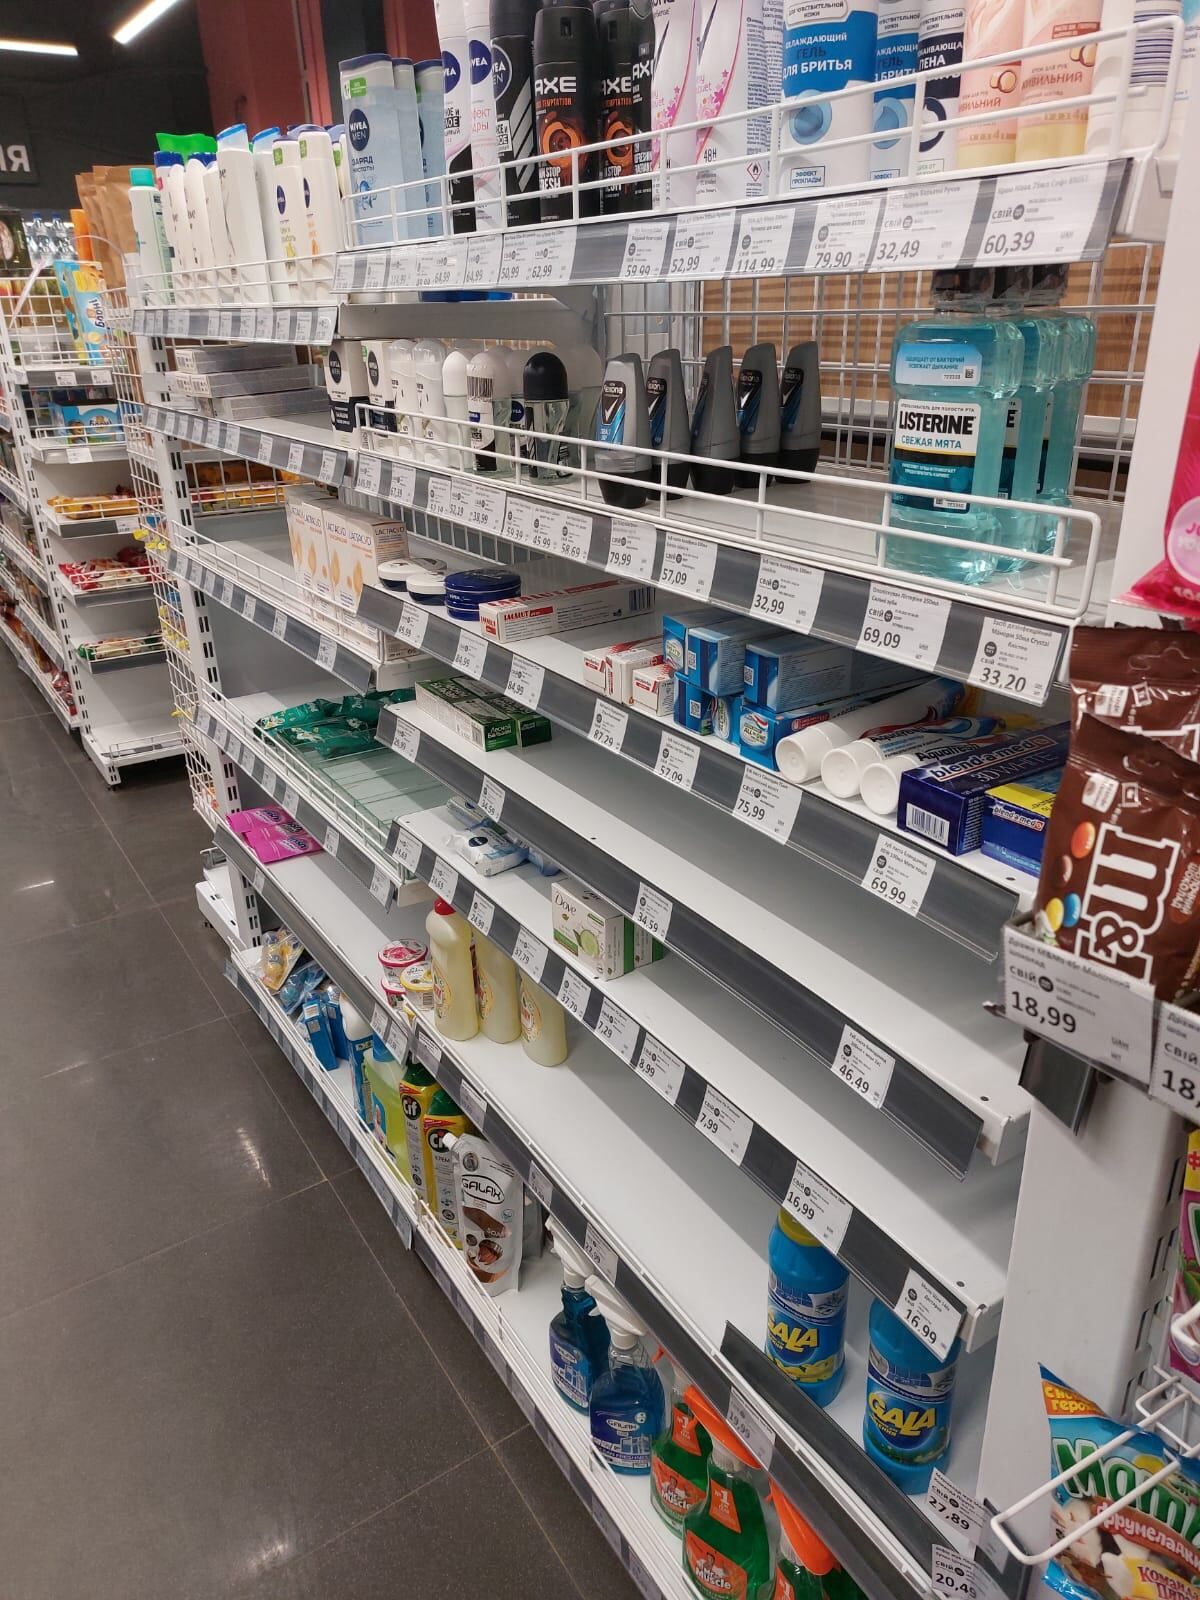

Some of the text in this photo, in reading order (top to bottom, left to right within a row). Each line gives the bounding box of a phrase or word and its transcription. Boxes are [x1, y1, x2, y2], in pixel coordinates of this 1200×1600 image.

[800, 59, 852, 74] БРИТЬЯ
[535, 76, 577, 95] AXE
[876, 239, 921, 261] 32,49
[983, 230, 1036, 256] 60,39
[670, 255, 700, 273] 52,99
[899, 410, 976, 435] LISTERINE
[901, 434, 962, 450] СВЕЖАЯ МЯТА
[609, 550, 632, 567] 79,99
[661, 568, 688, 586] 57,09
[753, 594, 786, 616] 32,99
[863, 626, 901, 649] 69,09
[737, 797, 766, 821] 75,99
[555, 892, 577, 916] Dove
[1009, 964, 1038, 984] СВІЙ
[1010, 990, 1078, 1034] 18,99
[1164, 1041, 1199, 1066] СВІЙ
[638, 1058, 656, 1078] 8,99
[403, 1102, 418, 1118] Cif
[700, 1112, 719, 1134] 7,99
[461, 1177, 501, 1200] GALAX
[787, 1190, 816, 1221] 16,99
[868, 1392, 937, 1436] GALA
[695, 1570, 732, 1590] Muscle
